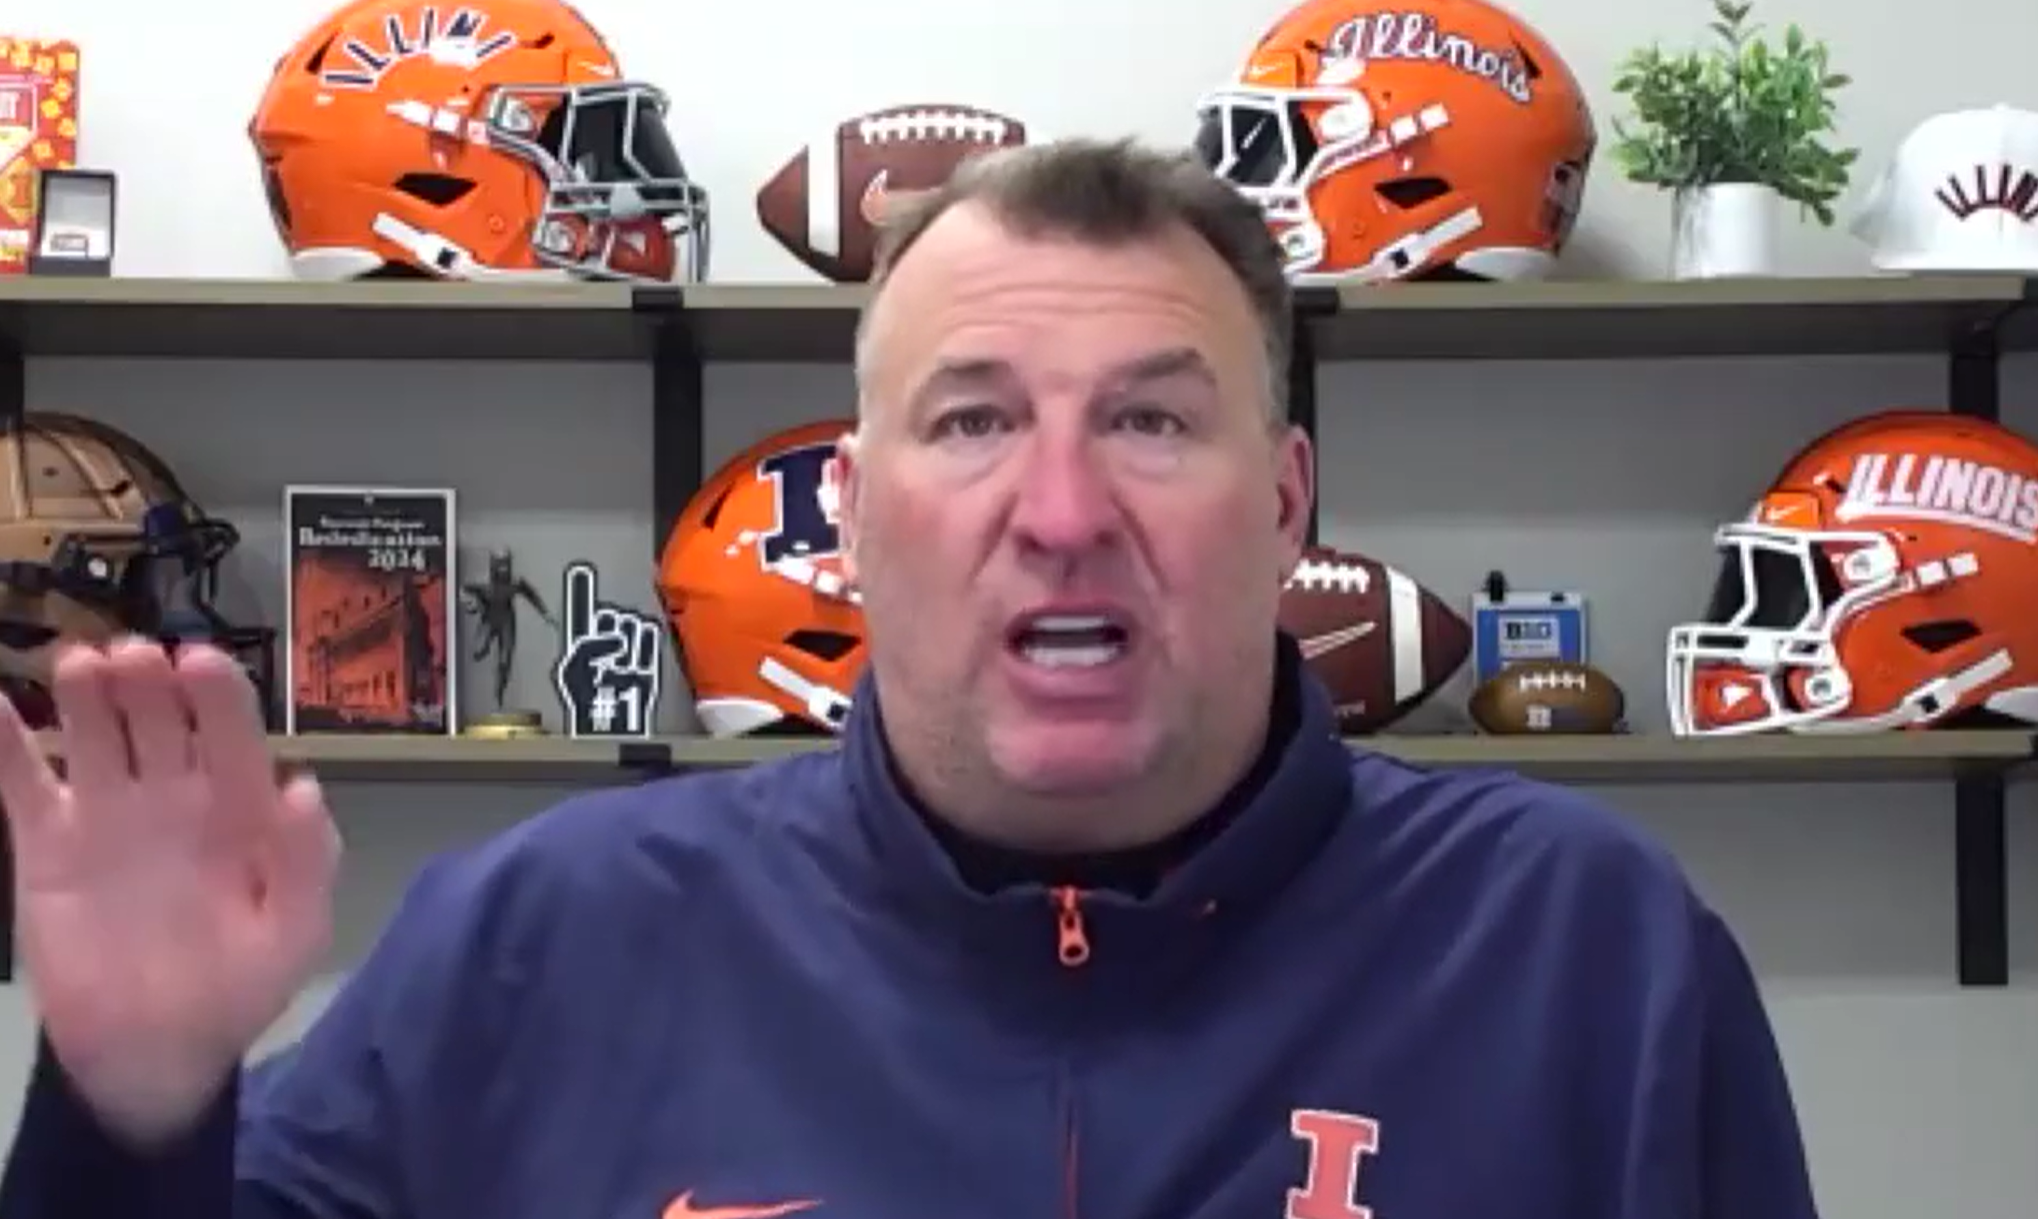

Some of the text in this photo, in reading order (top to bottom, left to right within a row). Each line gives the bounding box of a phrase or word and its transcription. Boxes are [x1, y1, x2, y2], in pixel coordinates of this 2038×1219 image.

[1316, 10, 1534, 104] Illinois
[1840, 452, 2038, 536] ILLINOIS
[588, 685, 642, 732] #1
[1285, 1107, 1379, 1219] I
